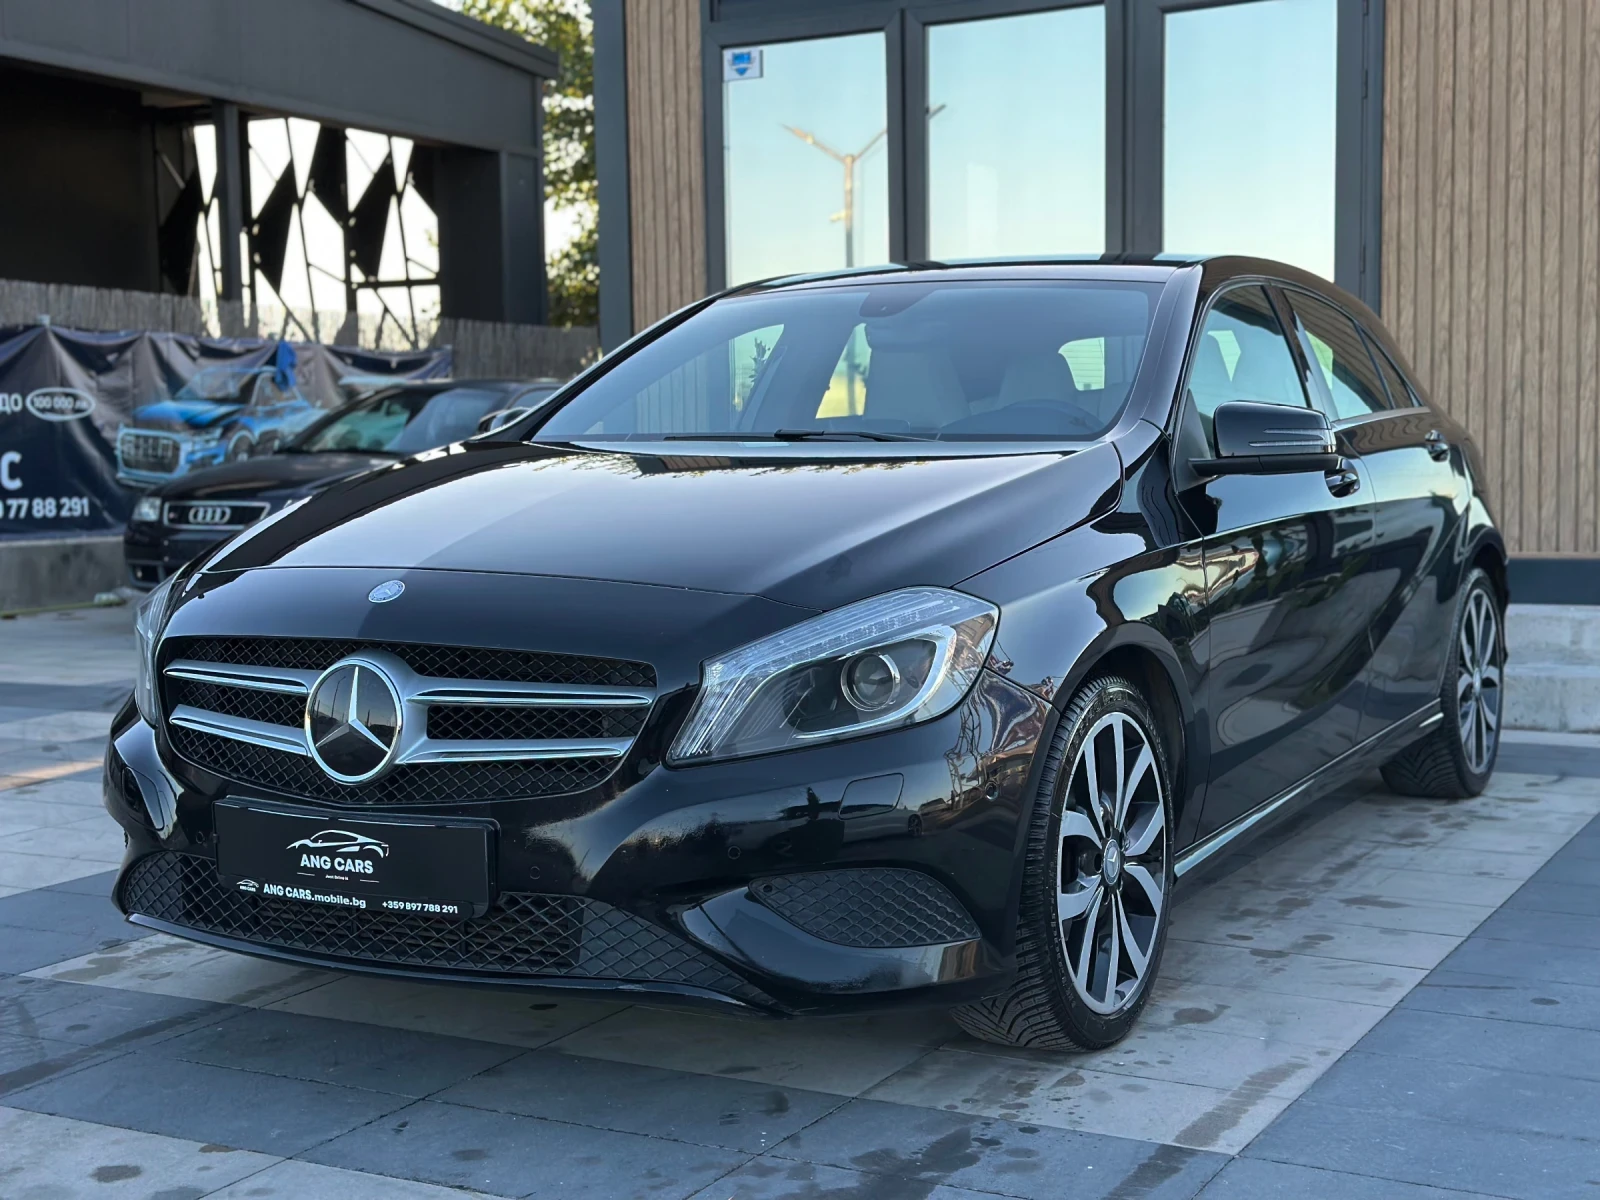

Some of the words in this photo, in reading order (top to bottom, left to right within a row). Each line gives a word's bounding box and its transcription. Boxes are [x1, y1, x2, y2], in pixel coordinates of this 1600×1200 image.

[6, 498, 29, 519] 77
[32, 497, 57, 519] 88
[60, 496, 89, 518] 291
[300, 854, 332, 870] ANG
[334, 857, 374, 874] CARS
[263, 883, 285, 896] ANG
[285, 886, 367, 909] CARS.mobile.bg
[382, 901, 405, 910] +359
[405, 902, 422, 911] 897
[423, 903, 440, 912] 788
[441, 905, 458, 914] 291
